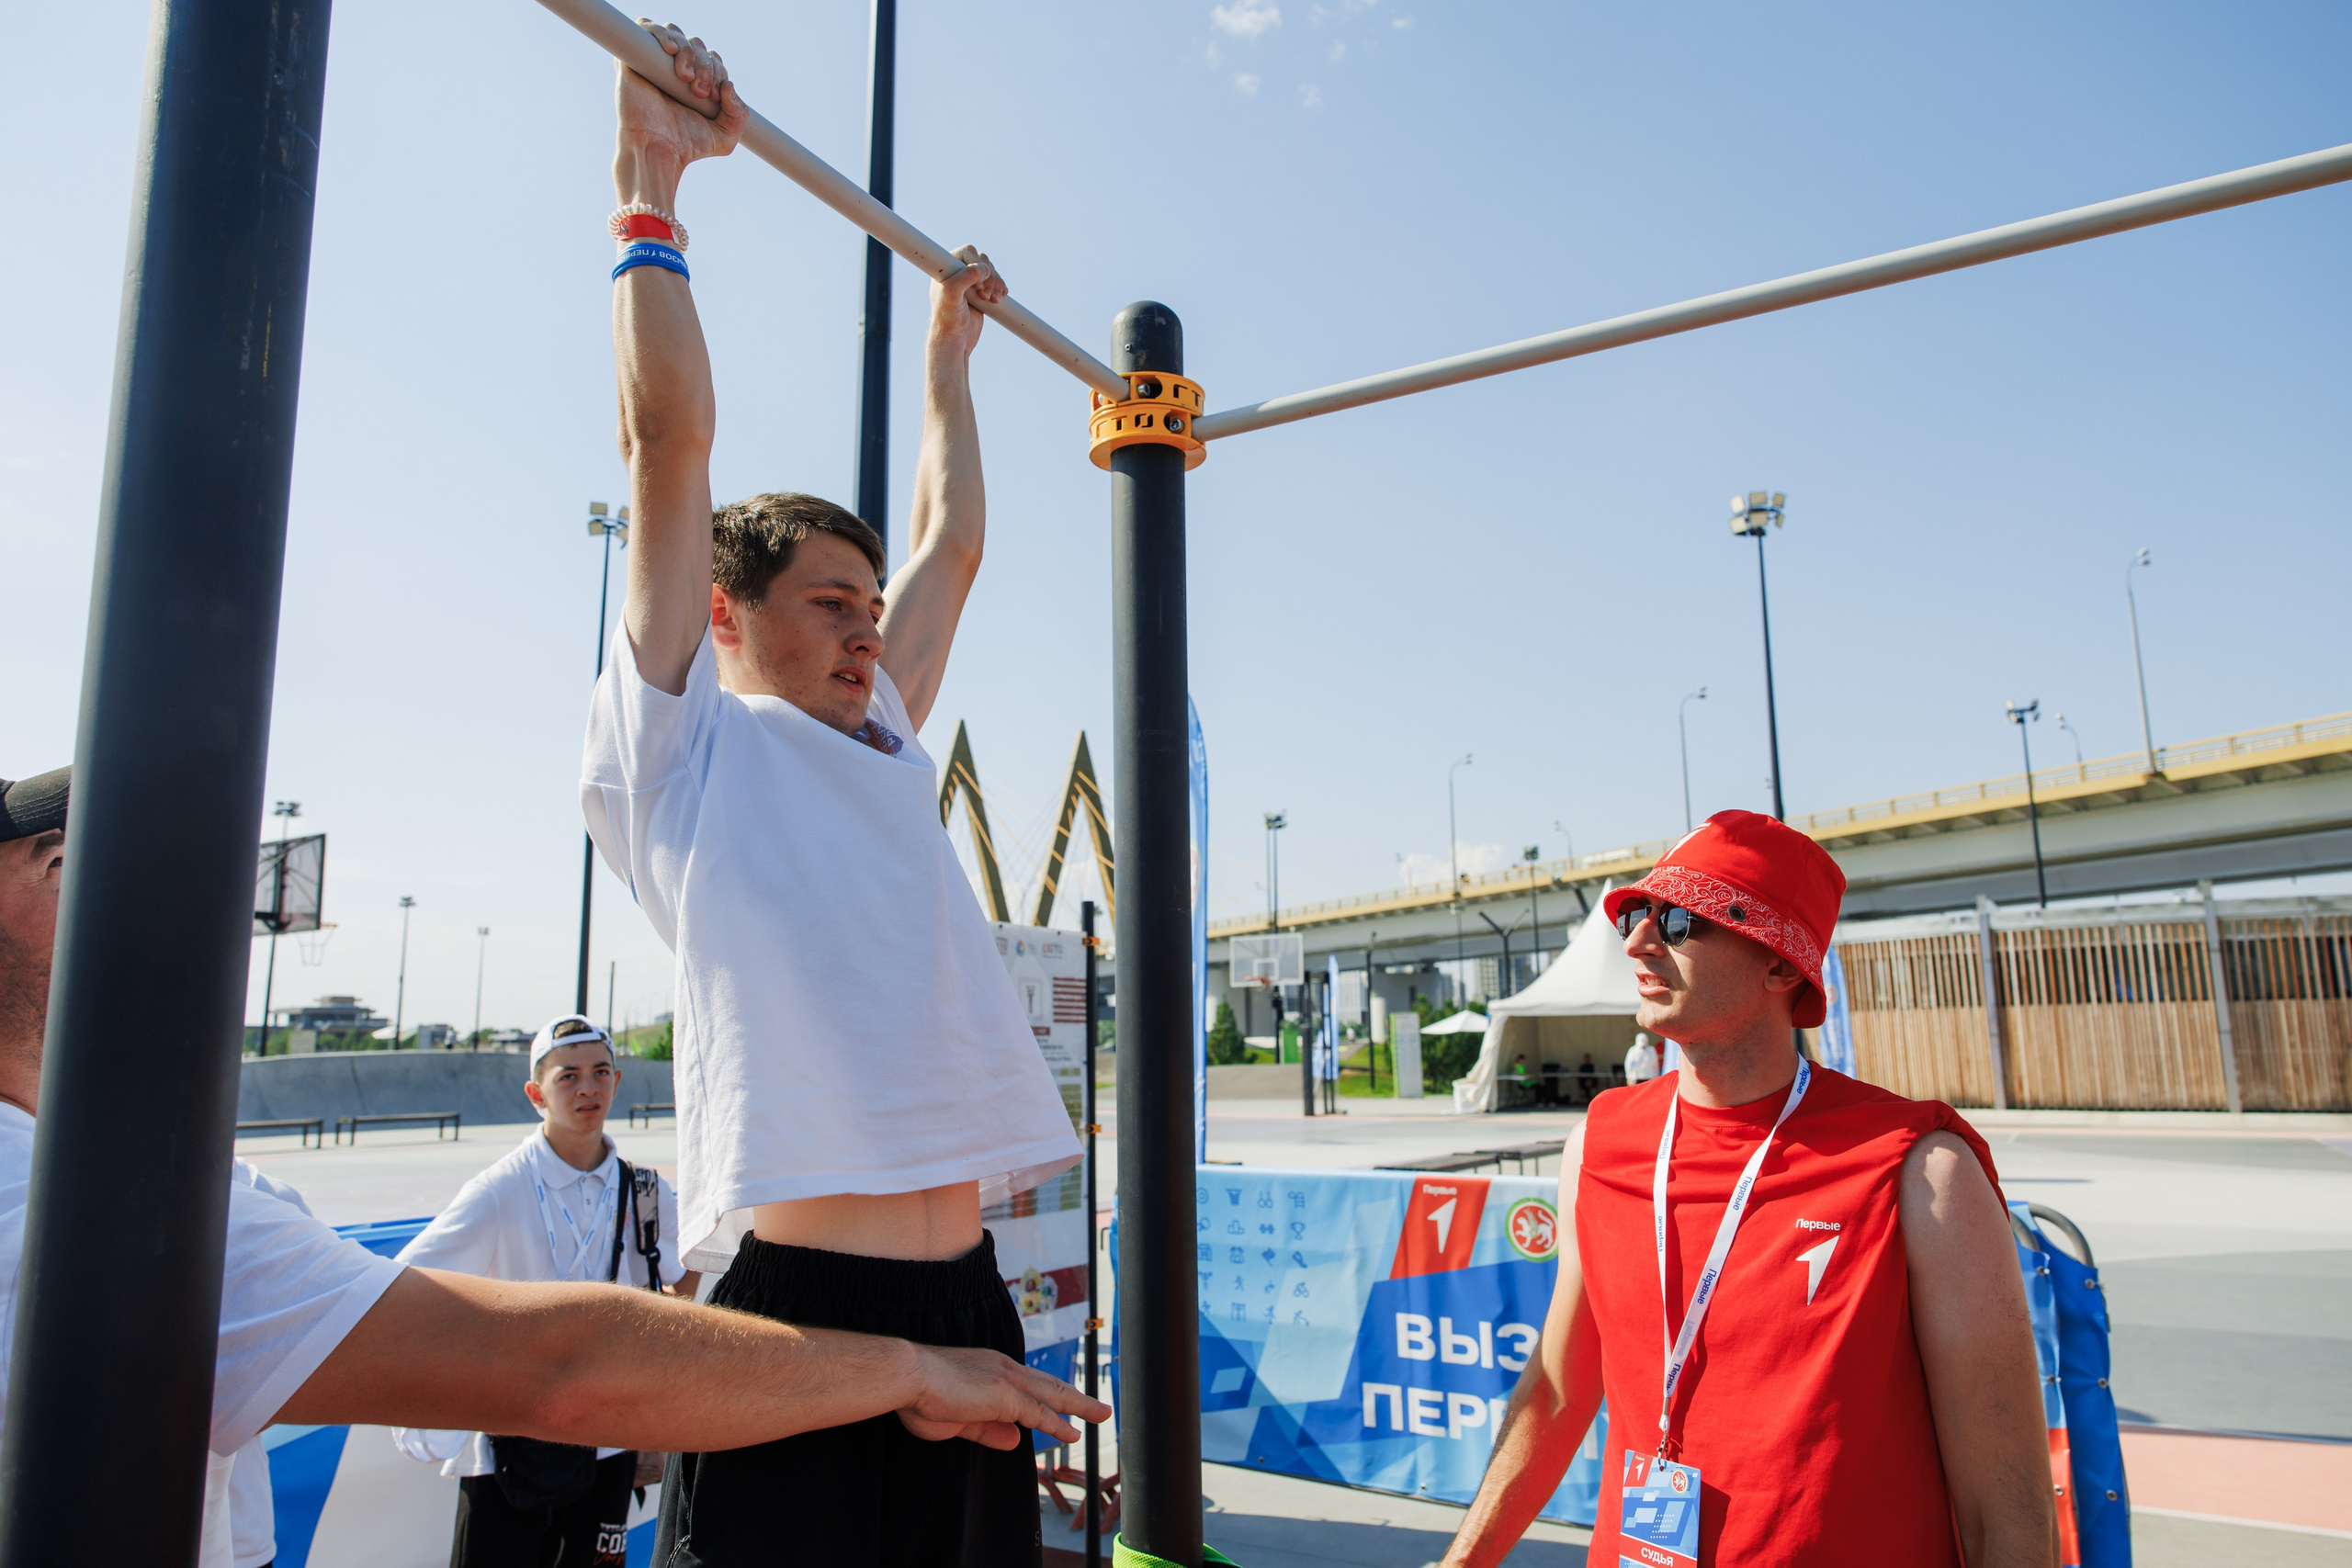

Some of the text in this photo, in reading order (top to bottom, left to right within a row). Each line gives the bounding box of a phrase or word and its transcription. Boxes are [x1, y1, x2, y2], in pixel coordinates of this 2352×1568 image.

[1173, 383, 1201, 407] ГТ
[1796, 1066, 1810, 1095] Первые
[1733, 1176, 1753, 1211] Первые
[1795, 1218, 1841, 1232] Первые
[1697, 1268, 1717, 1304] Первые
[1396, 1312, 1540, 1372] ВЫЗ
[1641, 1547, 1674, 1567] СУДЬЯ
